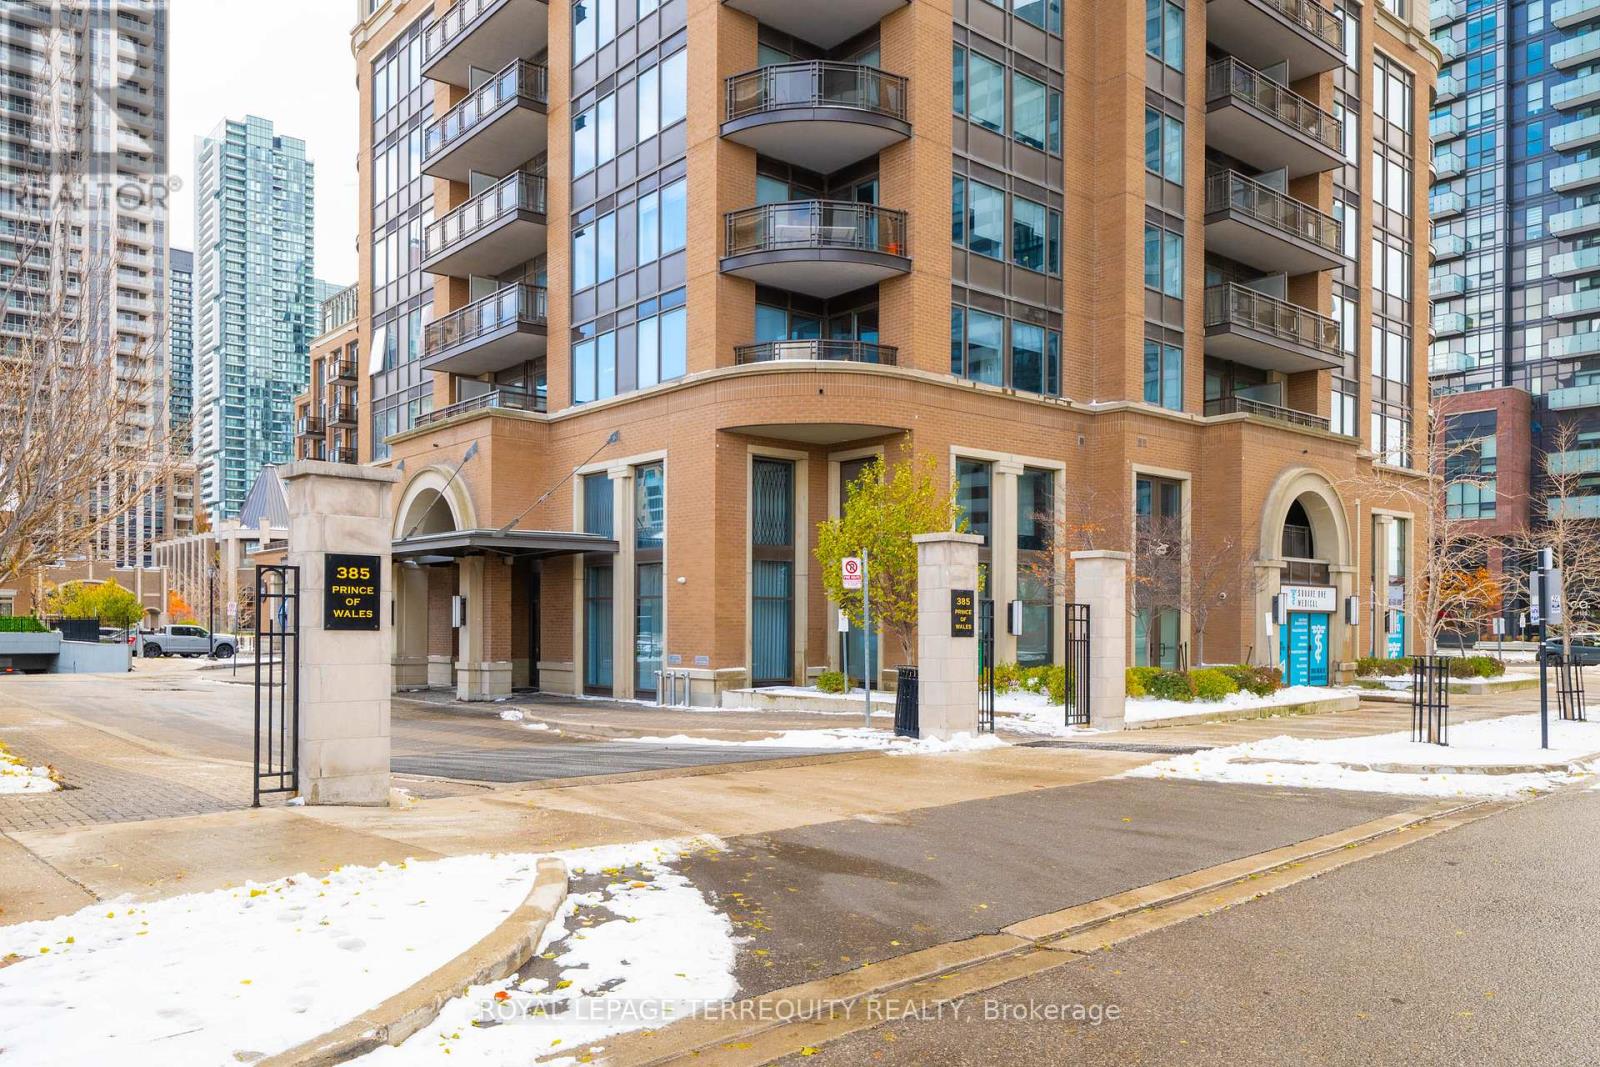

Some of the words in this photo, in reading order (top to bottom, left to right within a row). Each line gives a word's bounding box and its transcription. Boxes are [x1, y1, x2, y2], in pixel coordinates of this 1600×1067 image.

[336, 567, 370, 579] 385
[332, 586, 374, 595] PRINCE
[345, 598, 361, 606] OF
[956, 597, 971, 606] 385
[333, 609, 373, 618] WALES
